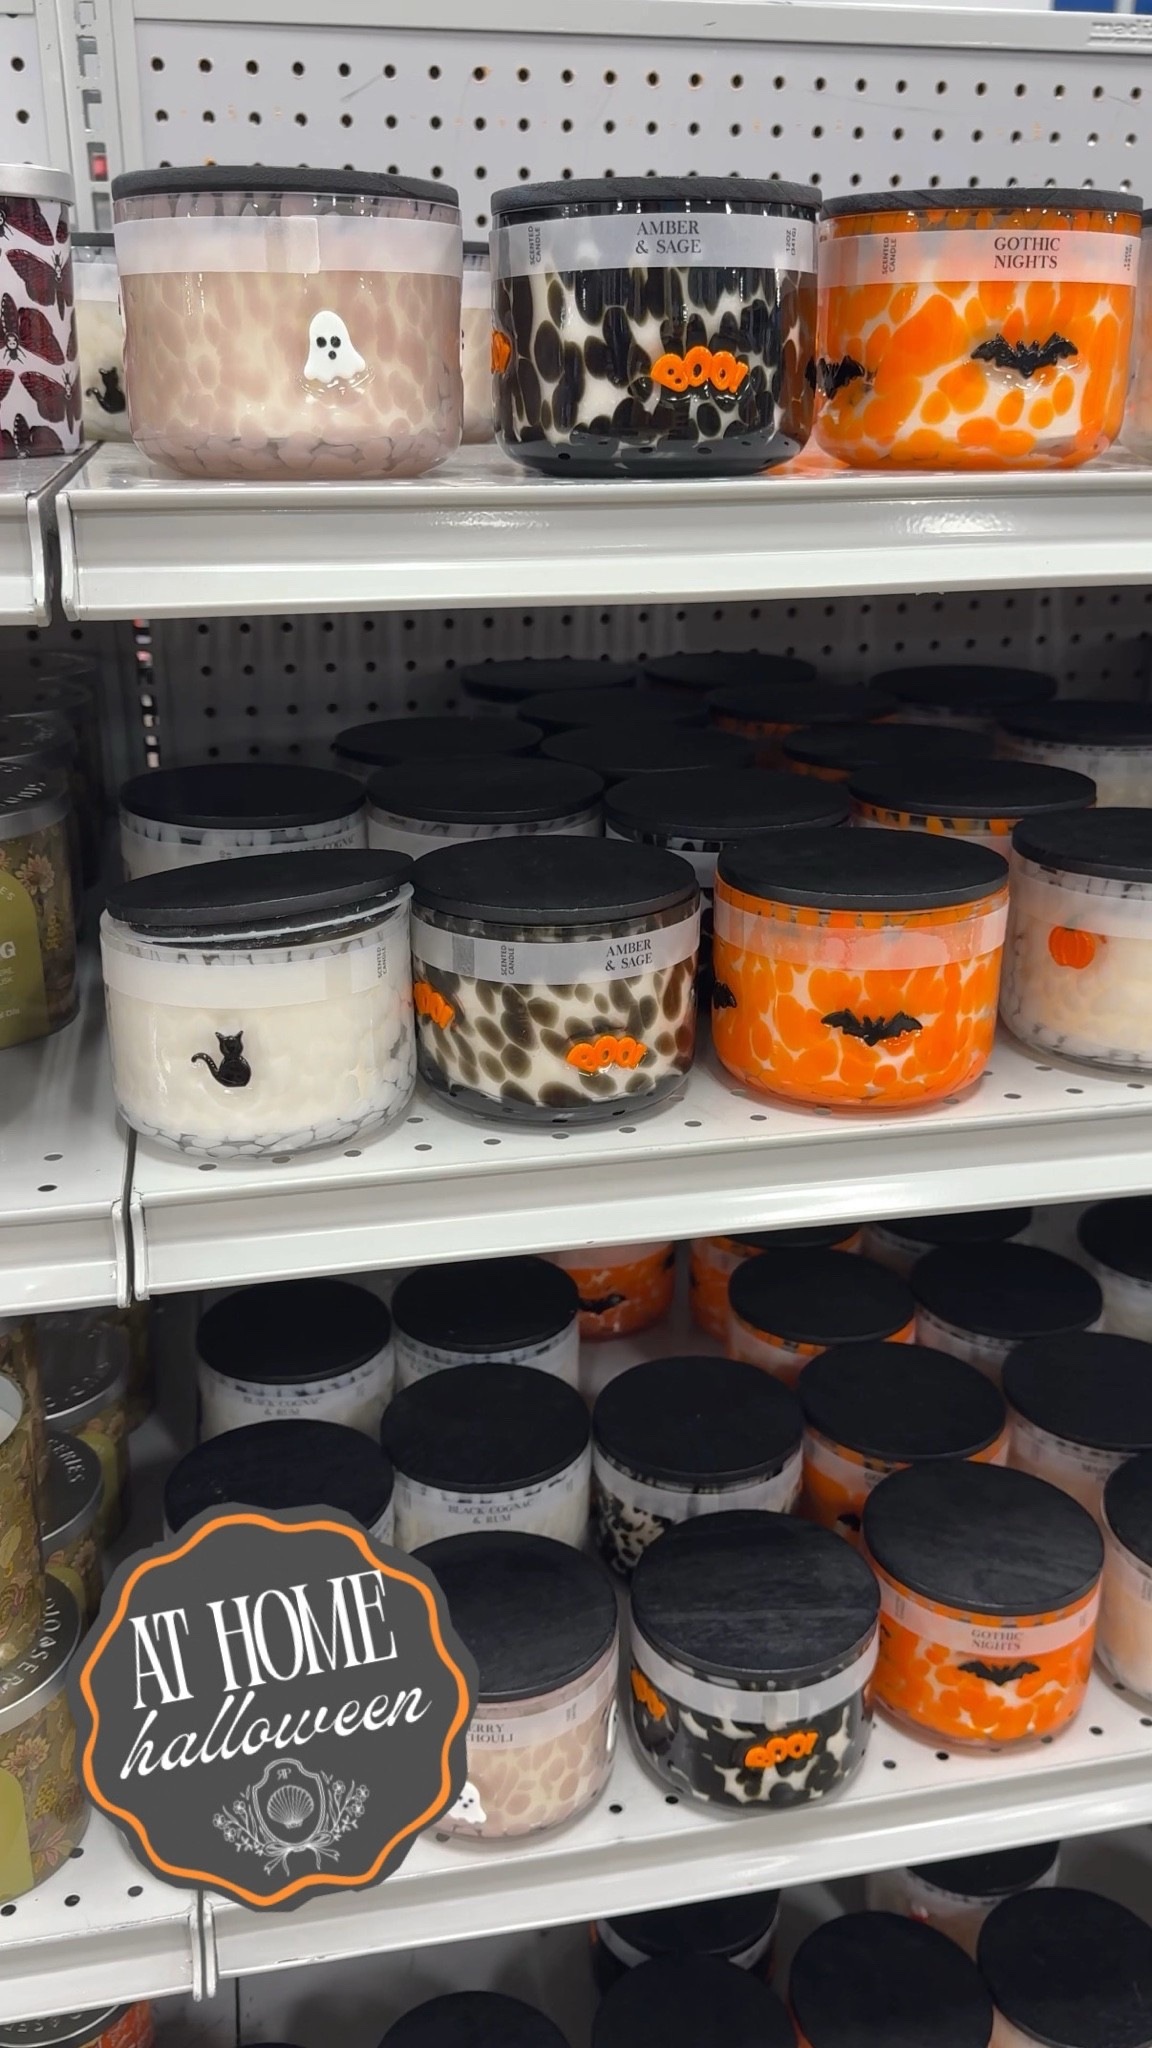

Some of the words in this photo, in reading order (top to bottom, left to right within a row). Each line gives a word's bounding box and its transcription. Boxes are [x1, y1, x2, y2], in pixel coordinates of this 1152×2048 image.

[636, 220, 700, 235] AMBER
[635, 239, 649, 255] &
[656, 239, 702, 254] SAGE
[994, 236, 1060, 251] GOTHIC
[994, 254, 1058, 269] NIGHTS
[606, 938, 652, 958] AMBER
[605, 960, 616, 972] &
[621, 952, 653, 970] SAGE
[448, 1503, 485, 1516] BLACK
[486, 1514, 512, 1524] RUM
[971, 1629, 1024, 1641] GOTHIC
[972, 1640, 1021, 1651] NIGHTS
